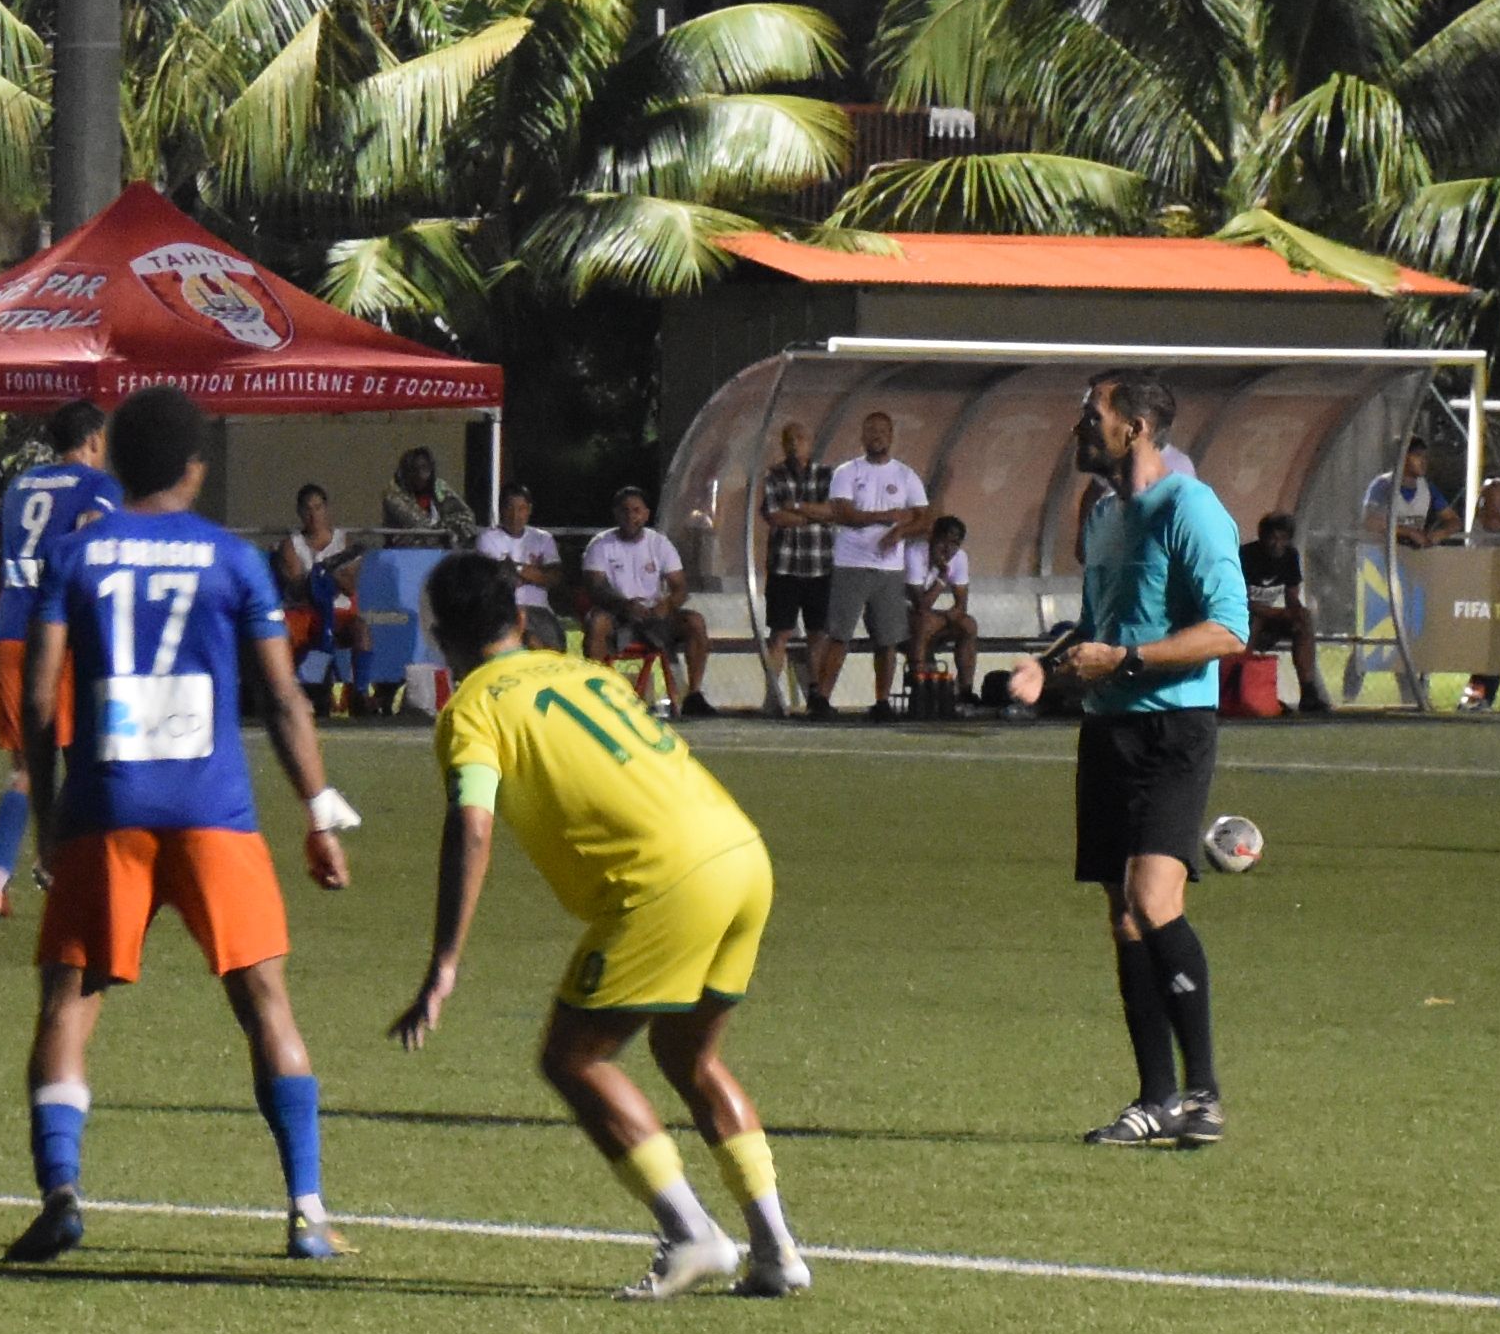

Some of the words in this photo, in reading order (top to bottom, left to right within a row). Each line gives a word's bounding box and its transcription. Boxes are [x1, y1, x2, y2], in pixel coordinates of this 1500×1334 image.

[149, 251, 235, 270] TAHITI
[34, 271, 108, 301] PAR
[4, 371, 82, 394] FOOTBALL
[242, 371, 355, 395] TAHITIENNE
[361, 375, 387, 396] DE
[21, 491, 54, 558] 9
[1454, 600, 1491, 619] FIFA
[97, 569, 199, 676] 17
